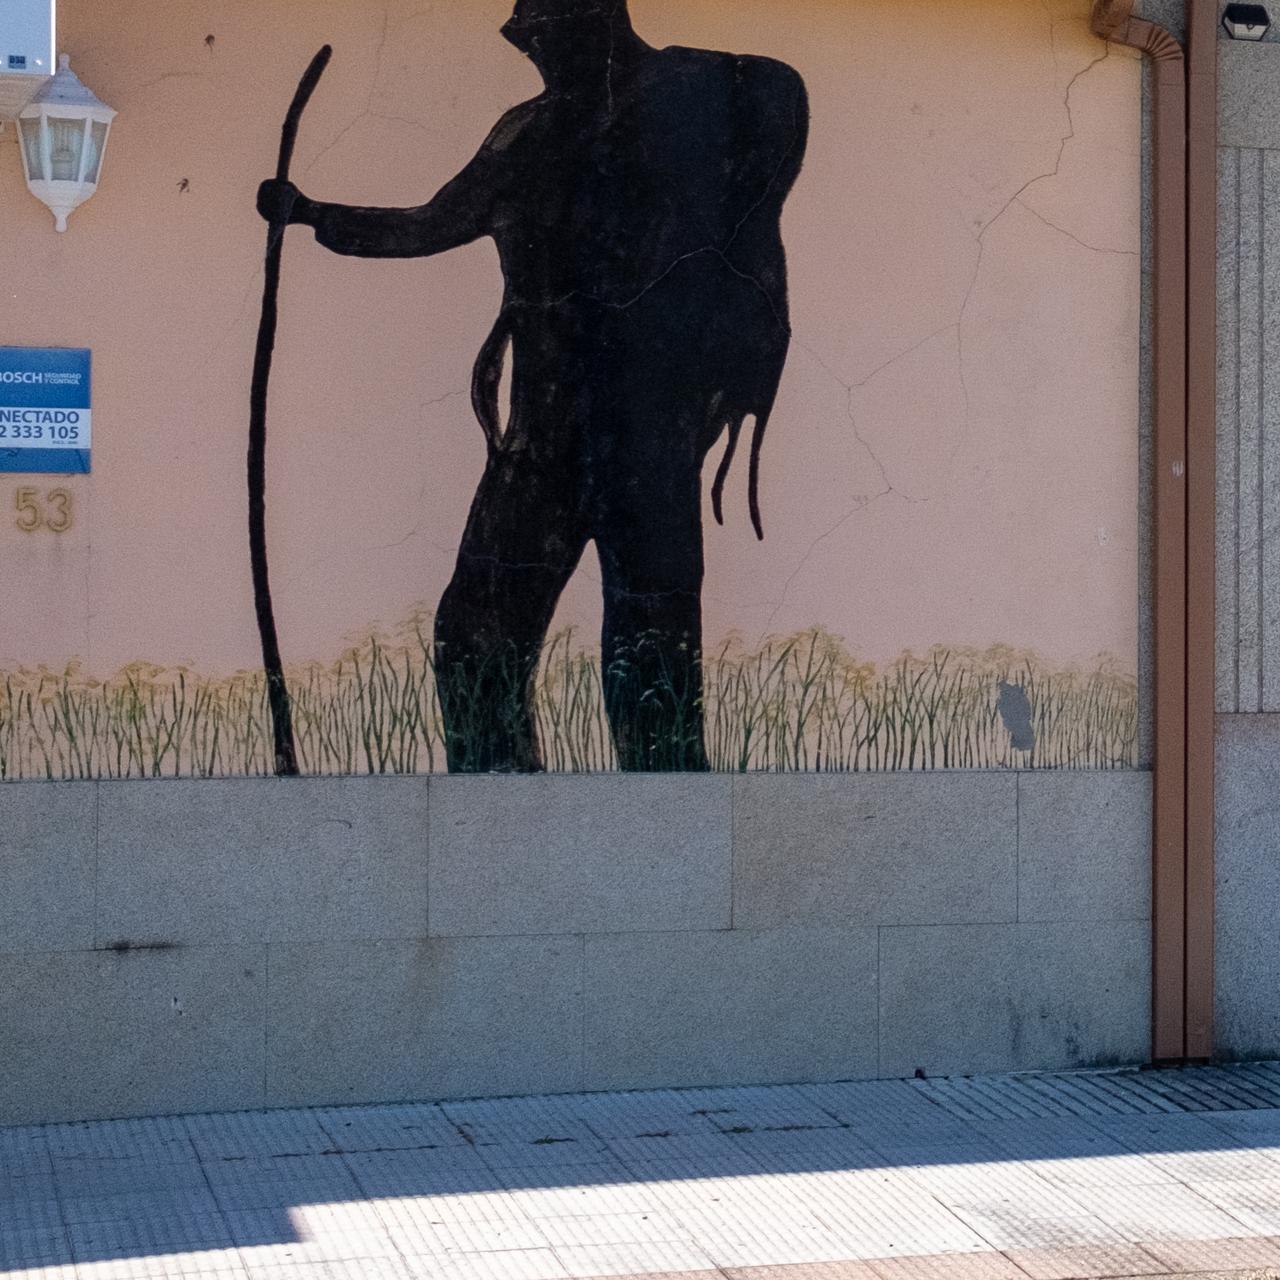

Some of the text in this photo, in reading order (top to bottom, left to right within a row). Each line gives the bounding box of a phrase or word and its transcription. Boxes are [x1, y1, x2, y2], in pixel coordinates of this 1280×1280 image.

[0, 371, 42, 384] OSCH
[11, 425, 43, 439] 333
[48, 426, 79, 439] 105
[16, 487, 73, 533] 53
